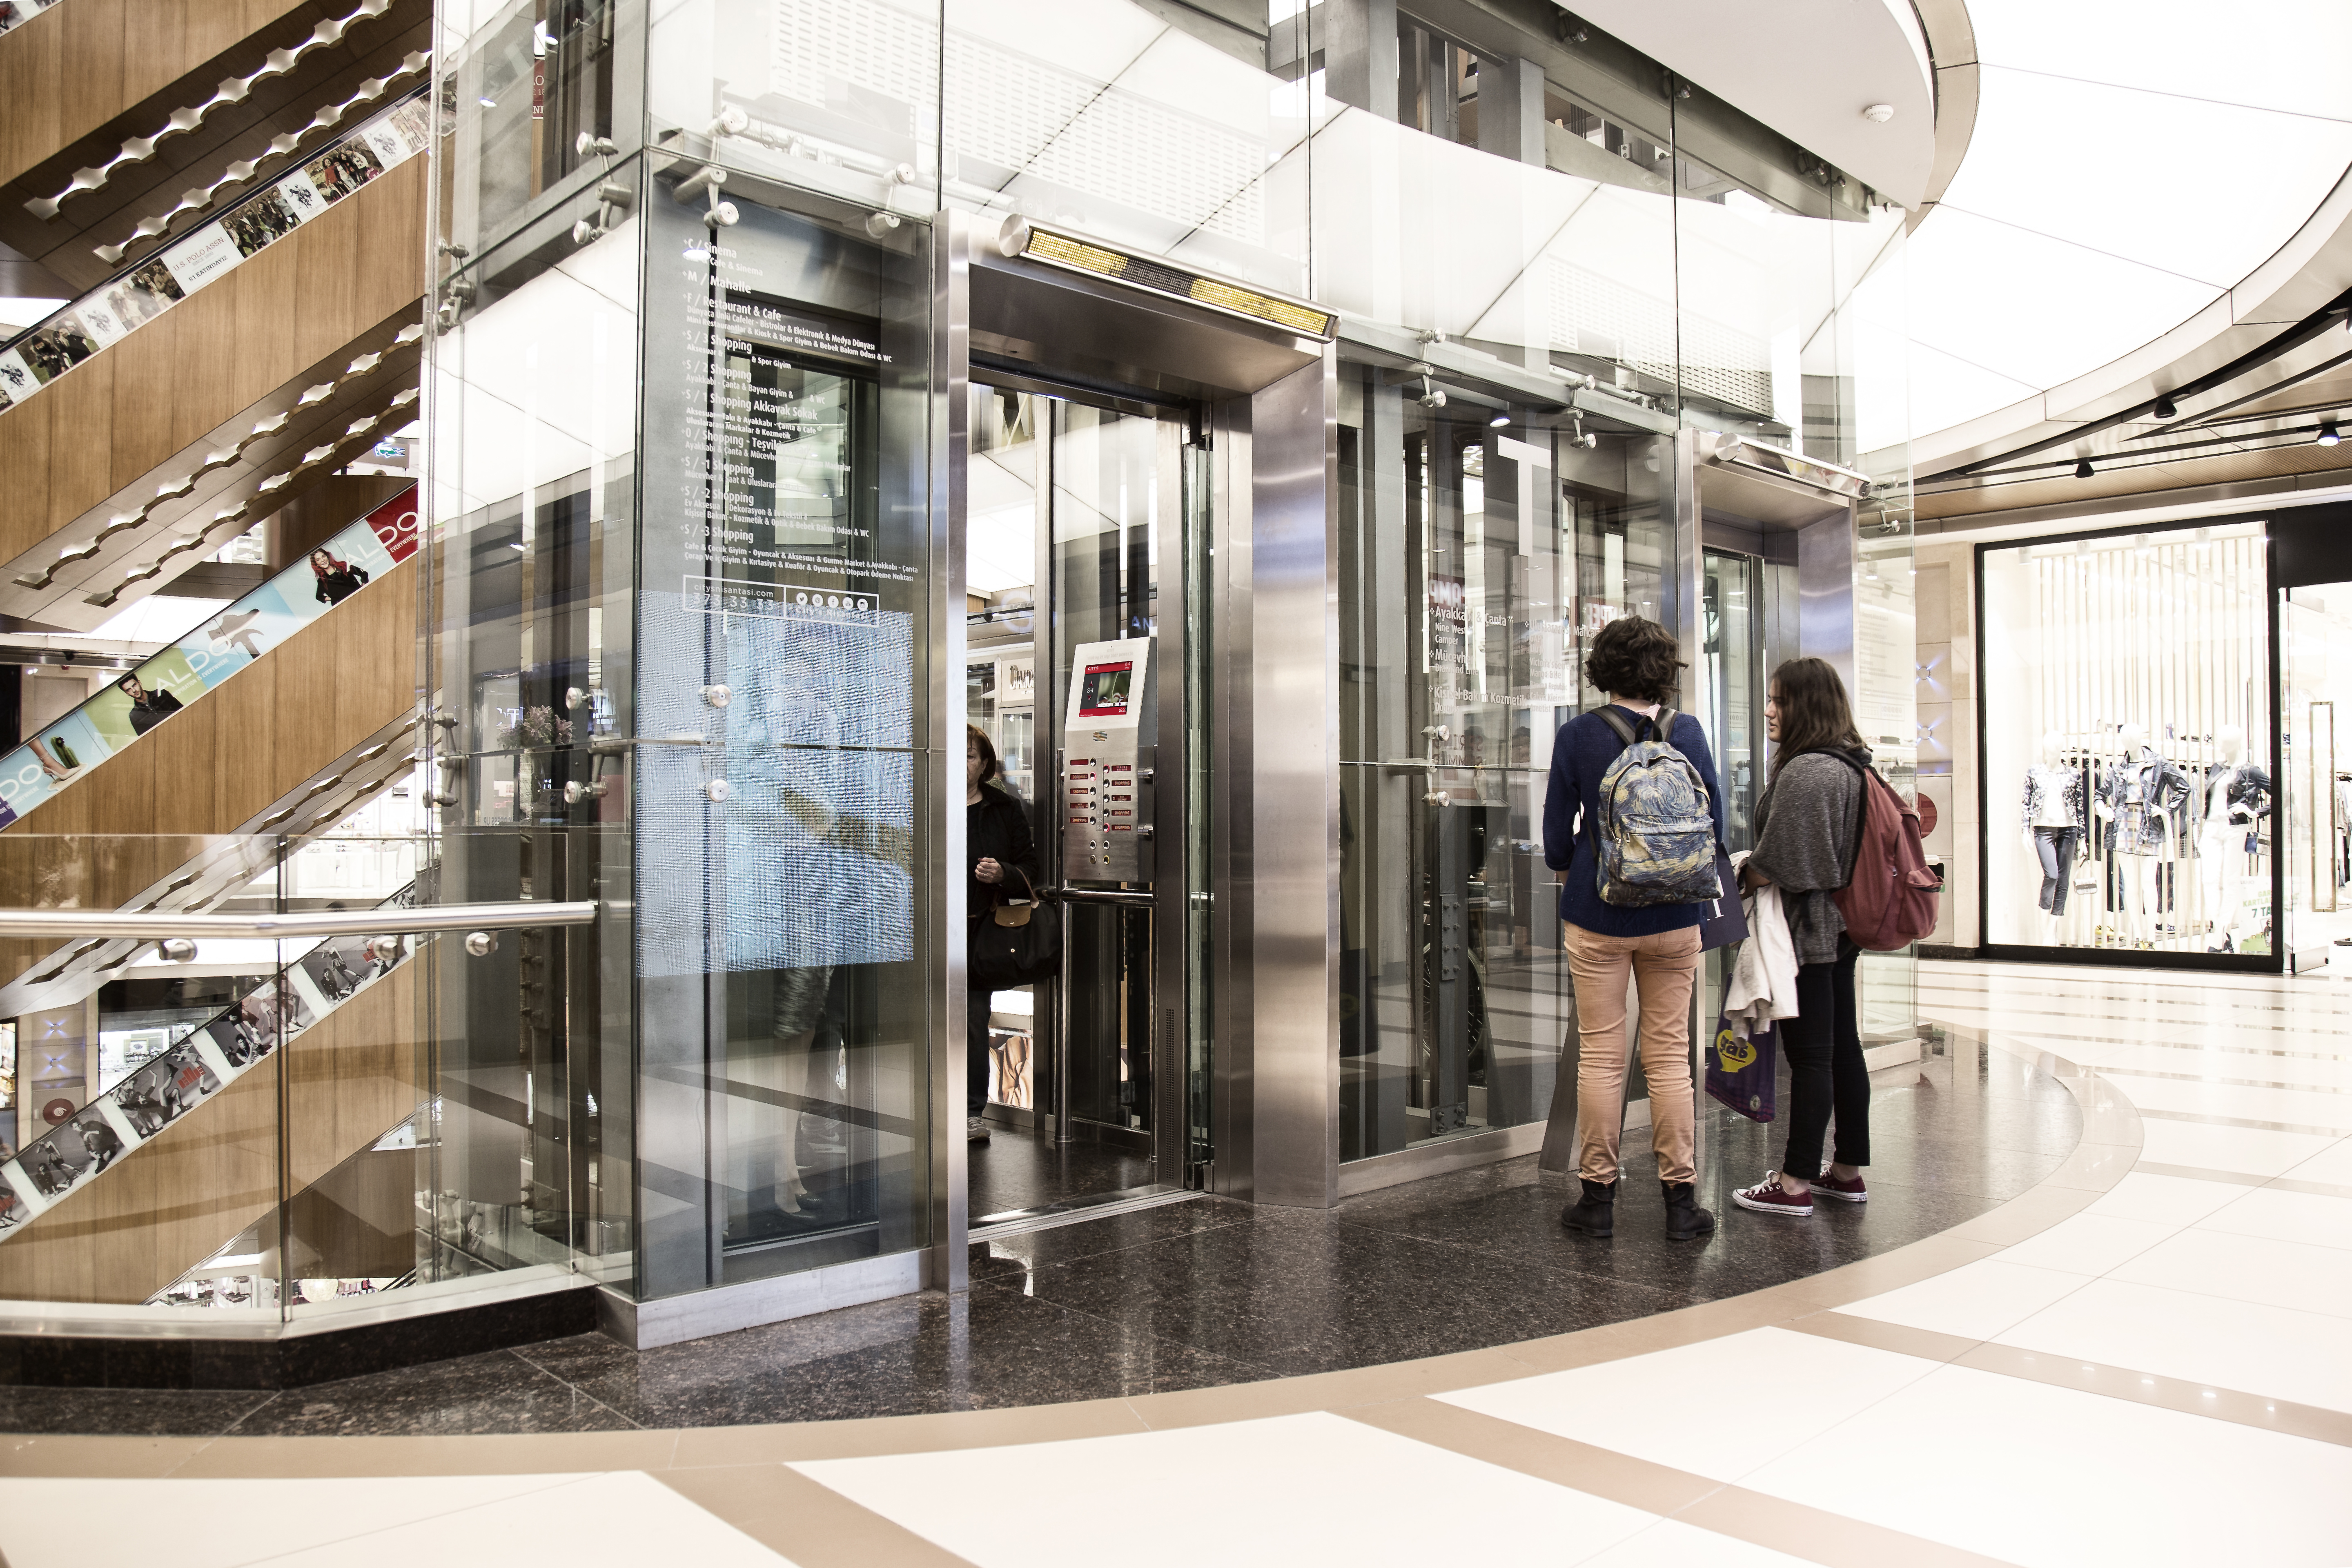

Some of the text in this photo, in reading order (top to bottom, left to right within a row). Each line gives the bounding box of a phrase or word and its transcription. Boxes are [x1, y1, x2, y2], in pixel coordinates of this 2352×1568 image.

[688, 238, 737, 258] C Sinema
[173, 261, 187, 271] U.S.
[186, 249, 205, 263] POLO
[195, 255, 228, 277] KATINDAYIZ
[710, 257, 726, 267] Cafe
[736, 263, 763, 276] Sinema
[688, 270, 751, 294] M Mahalle
[687, 293, 782, 321] F Restaurant Cafe
[687, 305, 715, 318] Dünyaca
[716, 310, 731, 321] Ünlü
[732, 314, 754, 325] Cafeler
[760, 320, 786, 332] Bistrolar
[832, 334, 851, 347] Medya
[852, 339, 875, 350] Dünyası
[686, 315, 892, 363] Mini Restaurantlar Kiosk Spor Giyim Bebek Bakım Odası WC
[686, 330, 752, 354] S 3 Shopping
[686, 360, 691, 370] S
[703, 362, 708, 372] 2
[687, 343, 791, 369] Aksesuar Spor Giyim
[686, 374, 825, 404] Ayakkabı Çanta Bayan Giyim WC
[686, 389, 818, 420] S 1 Shopping Akkavak Sokak
[686, 416, 791, 439] Uluslararası Markalar Kozmetik
[722, 412, 735, 421] Takı
[743, 416, 772, 428] Ayakkabı
[778, 422, 795, 431] Çanta
[685, 456, 754, 478] S -1 Shopping
[686, 441, 715, 452] Ayakkabı
[724, 447, 742, 456] Çanta
[825, 461, 851, 472] Markalar
[685, 470, 716, 481] Mücevher
[725, 475, 739, 484] Saat
[685, 486, 754, 506] S -2 Shopping
[1497, 435, 1551, 557] T
[685, 508, 869, 537] Kişisel Bakım Kozmetik Optik Bebek Bakım Odası WC
[729, 504, 766, 516] Dekorasyon
[782, 511, 802, 520] Tekstil
[346, 512, 418, 572] ALDO
[390, 532, 416, 553] EVERYWHERE
[684, 524, 754, 544] S -3 Shopping
[685, 552, 703, 561] Çorap
[722, 556, 741, 564] Giyim
[749, 558, 777, 568] Kırtasiye
[785, 562, 805, 570] Kuaför
[813, 565, 839, 574] Oyuncak
[846, 568, 869, 577] Otopark
[871, 570, 891, 579] Ödeme
[893, 573, 914, 581] Noktası
[708, 545, 727, 553] Çocuk
[728, 546, 747, 555] Giyim
[753, 549, 780, 559] Oyuncak
[823, 557, 843, 565] Gurme
[844, 559, 865, 568] Market
[902, 565, 918, 574] Çanta
[694, 584, 774, 597] citysnisantasi.com
[694, 593, 774, 610] 373 33 33
[1435, 622, 1449, 632] Nine
[1485, 613, 1506, 627] Çanta
[1435, 635, 1459, 646] Camper
[157, 636, 233, 697] ALDO
[201, 657, 229, 678] EVERYWHERE
[1530, 668, 1547, 680] Mango
[1490, 692, 1526, 706] Kozmetik
[1548, 693, 1561, 702] Klein
[0, 764, 42, 801] DO
[2252, 909, 2257, 918] 7
